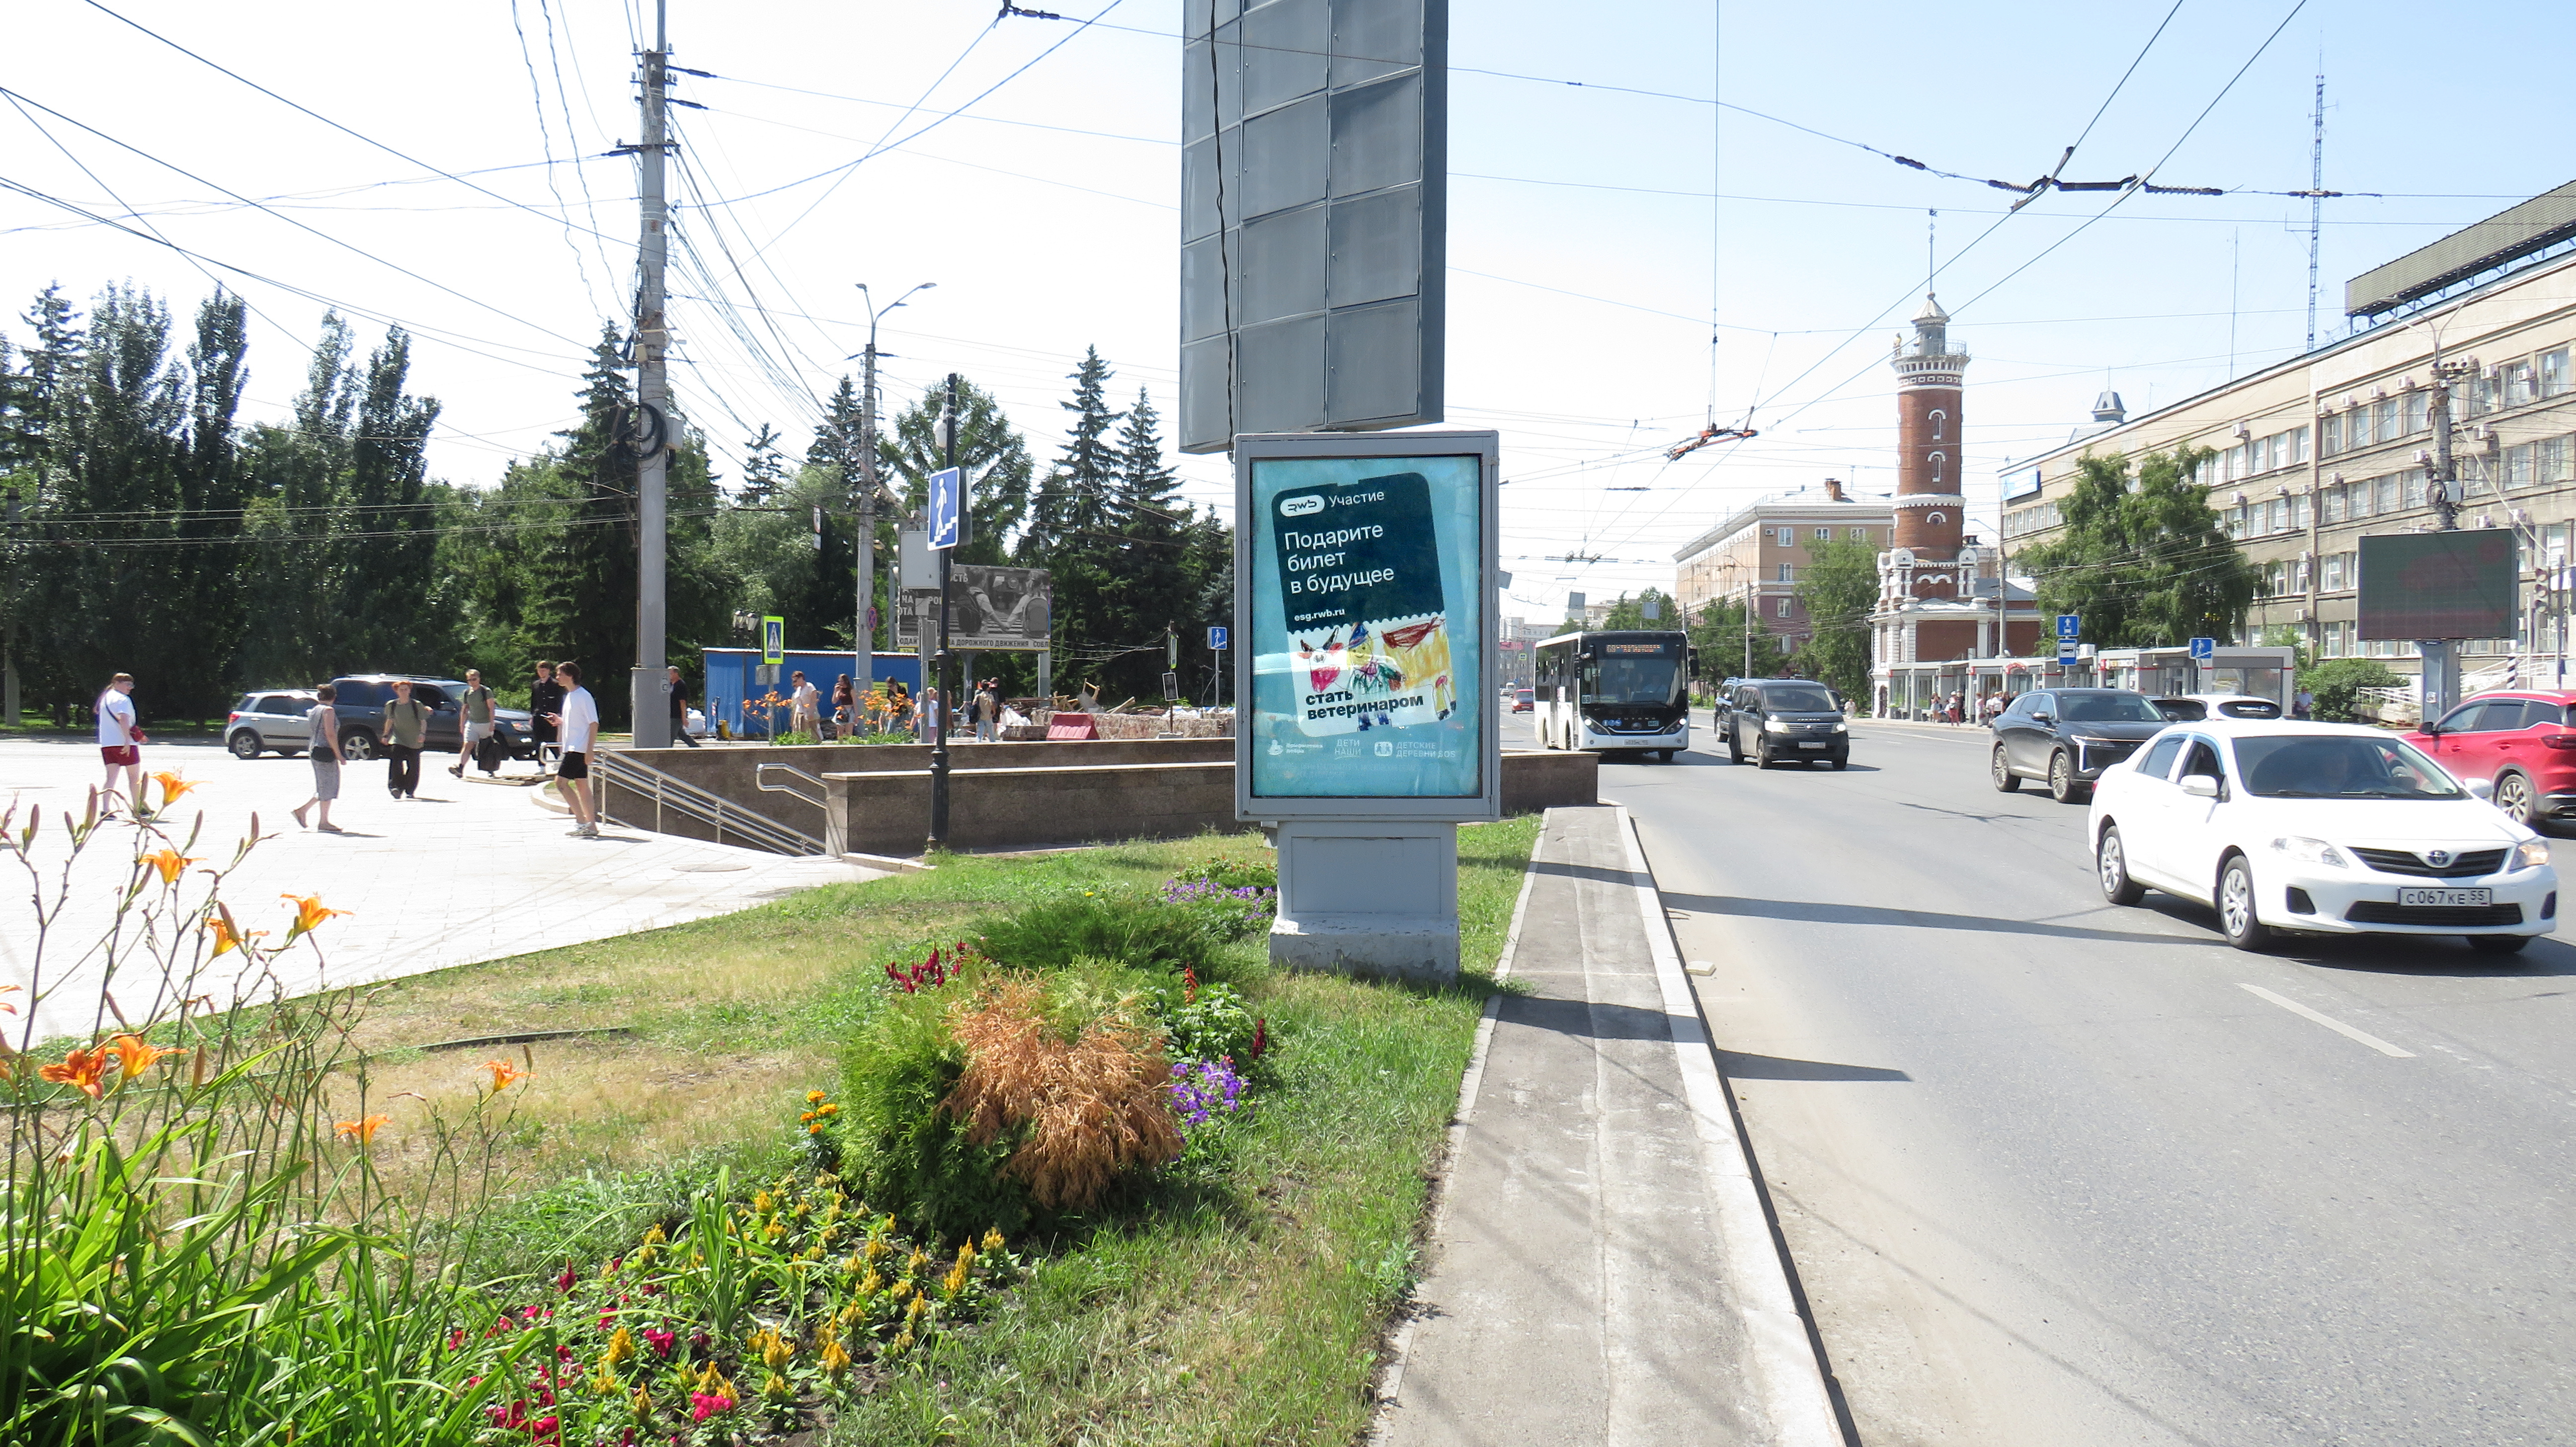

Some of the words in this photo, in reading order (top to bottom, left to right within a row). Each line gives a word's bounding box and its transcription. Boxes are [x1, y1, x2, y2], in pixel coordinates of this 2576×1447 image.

[1328, 491, 1384, 507] Участие
[1285, 524, 1383, 550] Подарите
[1288, 552, 1346, 572] билет
[1290, 581, 1302, 594] в
[1306, 568, 1394, 594] будущее
[1294, 608, 1345, 622] esg.rwb.ru
[956, 638, 994, 647] ДОРОЖНОГО
[1306, 690, 1354, 706] стать
[1307, 695, 1424, 720] ветеринаром
[1336, 739, 1360, 747] ДЕТИ
[1334, 747, 1362, 756] НАШИ
[1396, 750, 1436, 758] ДЕРЕВНИ
[2407, 890, 2465, 904] С067КЕ
[2470, 890, 2484, 900] 55
